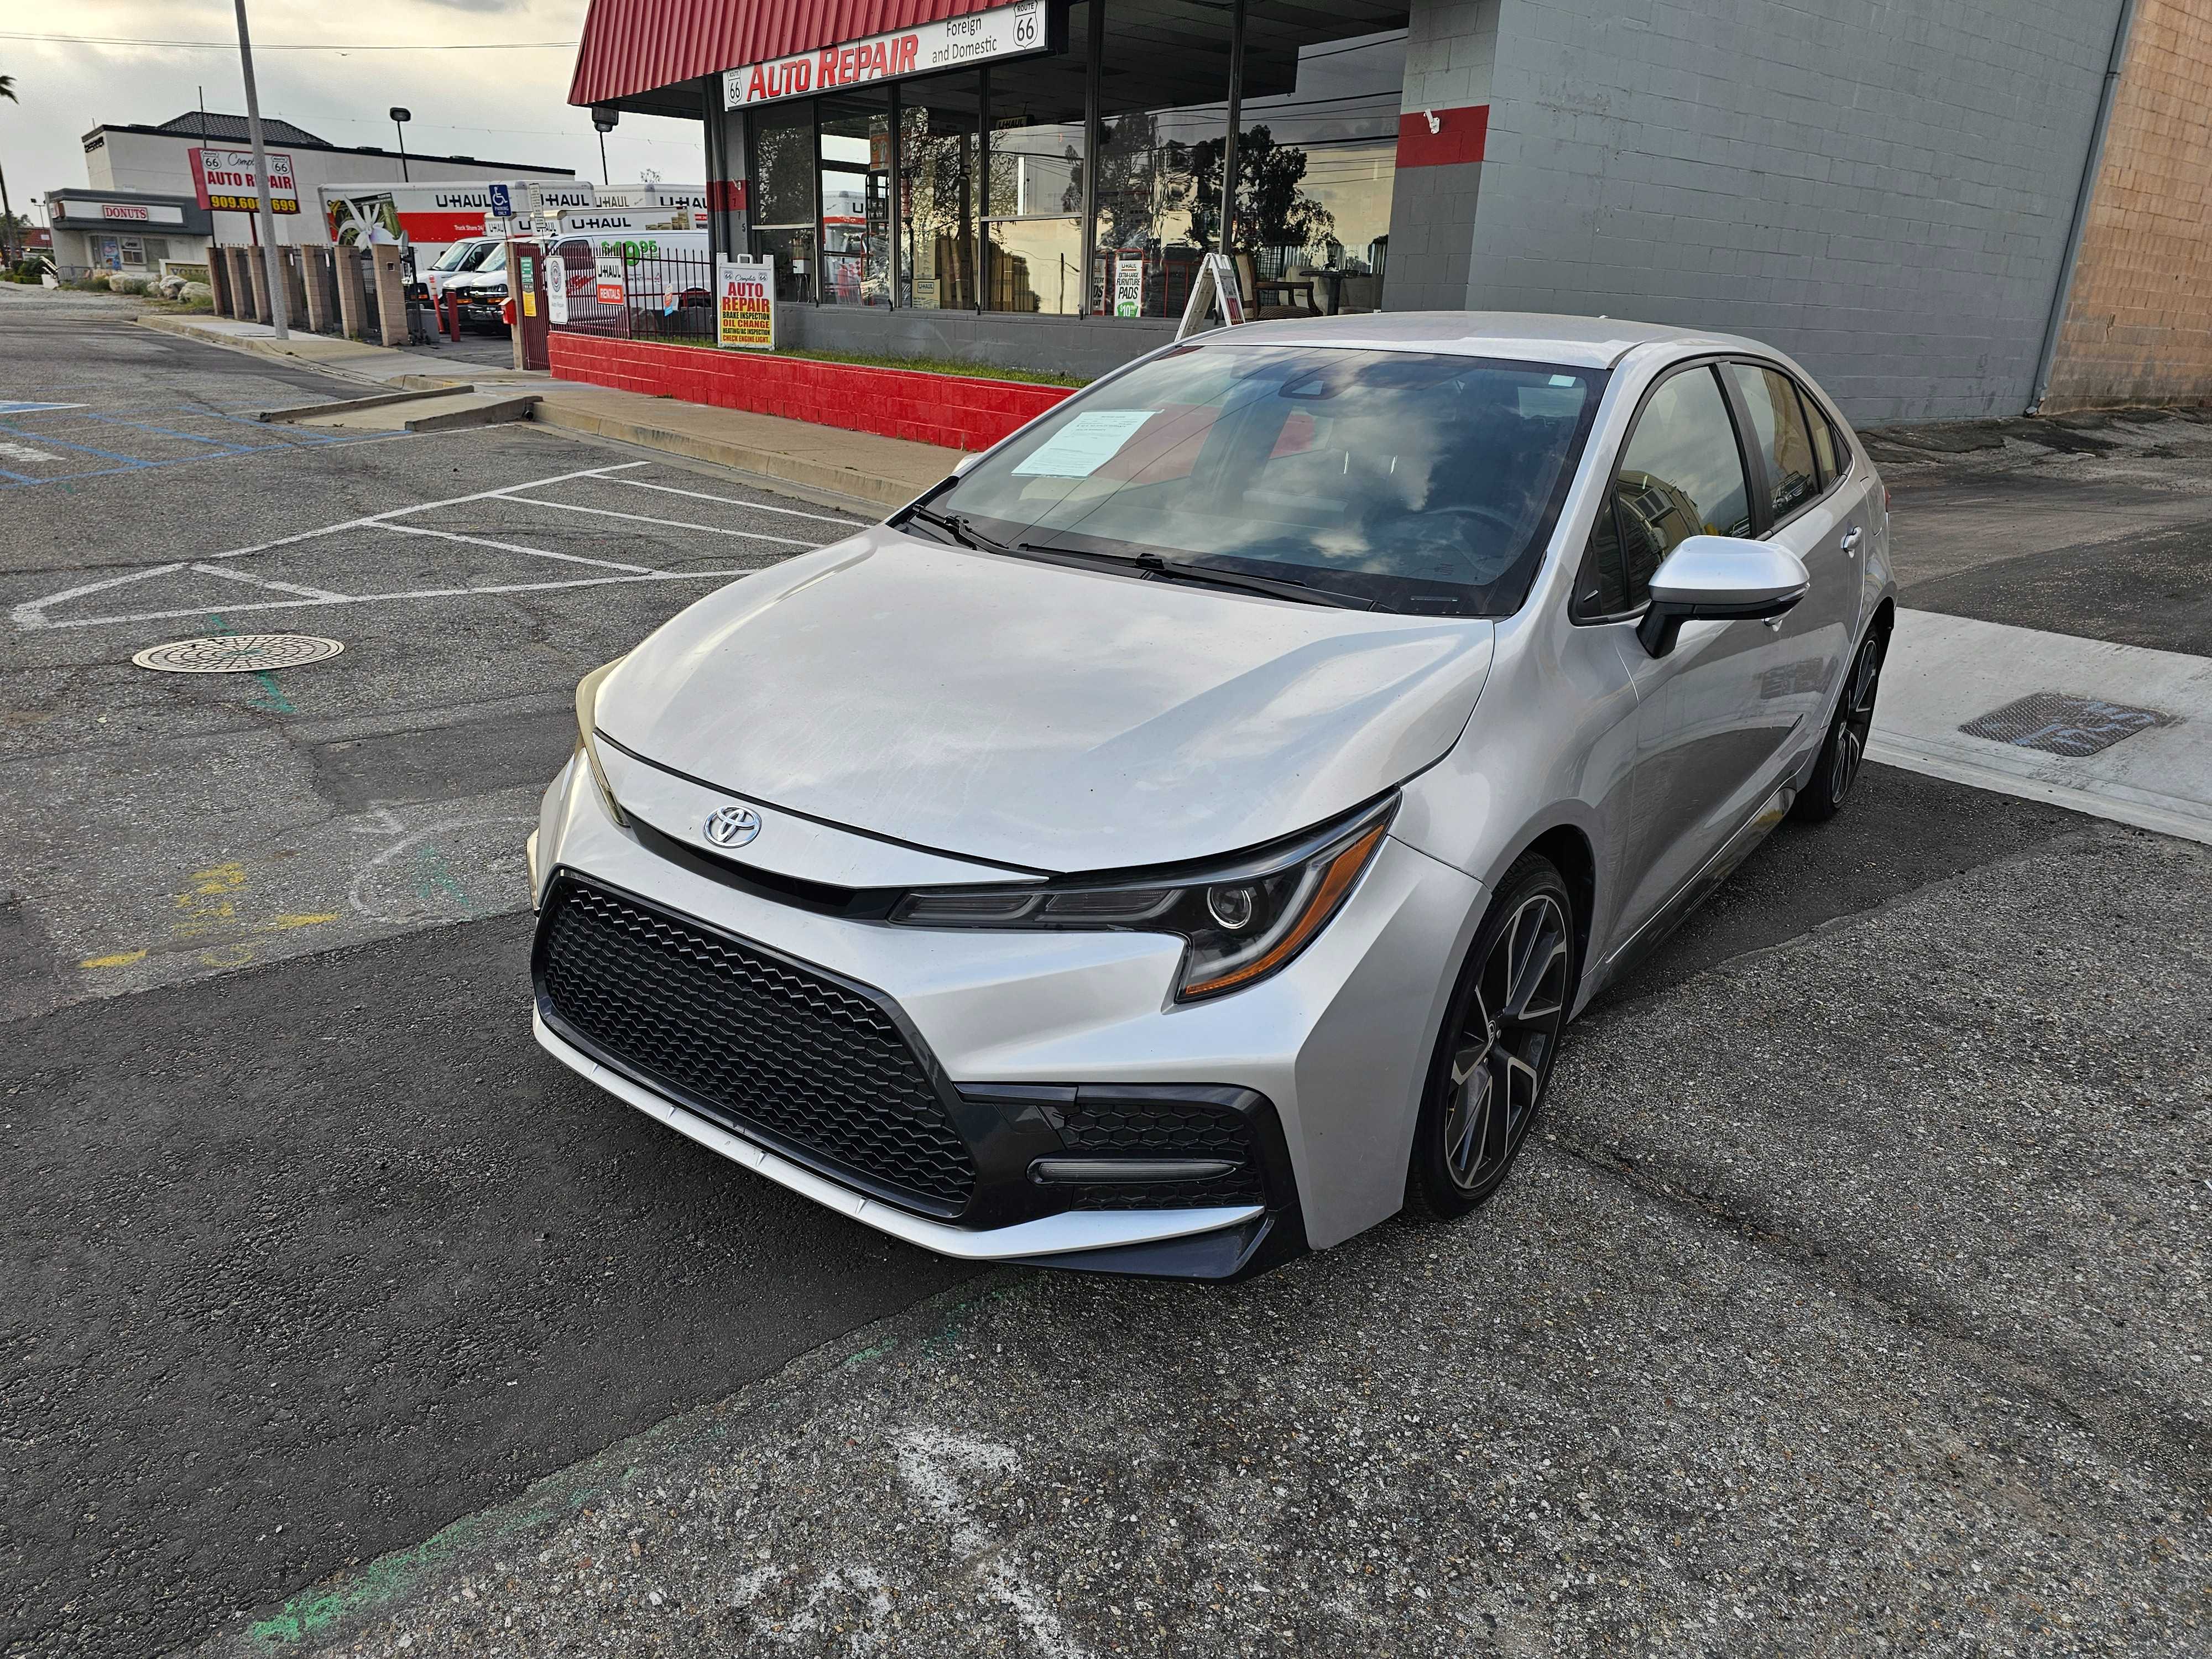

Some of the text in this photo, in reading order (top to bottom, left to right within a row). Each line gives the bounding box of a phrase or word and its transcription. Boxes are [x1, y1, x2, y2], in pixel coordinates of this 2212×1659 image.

[1018, 2, 1035, 12] ROUTE
[946, 16, 982, 37] Foreign
[1016, 17, 1034, 41] 66
[932, 35, 998, 64] and Domestic
[746, 34, 919, 102] AUTO REPAIR
[730, 82, 740, 98] 66
[206, 158, 219, 167] 66
[228, 152, 254, 169] Comp
[276, 163, 288, 172] 66
[208, 171, 293, 189] AUTO RAIR
[211, 196, 296, 211] 909.60699
[435, 194, 492, 208] U-HAUL
[660, 196, 707, 208] U-HA
[105, 207, 147, 219] DONUTS
[571, 217, 632, 229] U-HAUL
[597, 265, 621, 278] U-HAUL
[599, 288, 620, 299] RENTALS
[728, 281, 763, 298] AUTO
[1118, 286, 1139, 299] PADS
[722, 296, 770, 313] REPAIR
[723, 311, 770, 321] BRAKE INSPECTION
[723, 319, 770, 329] OIL CHANGE
